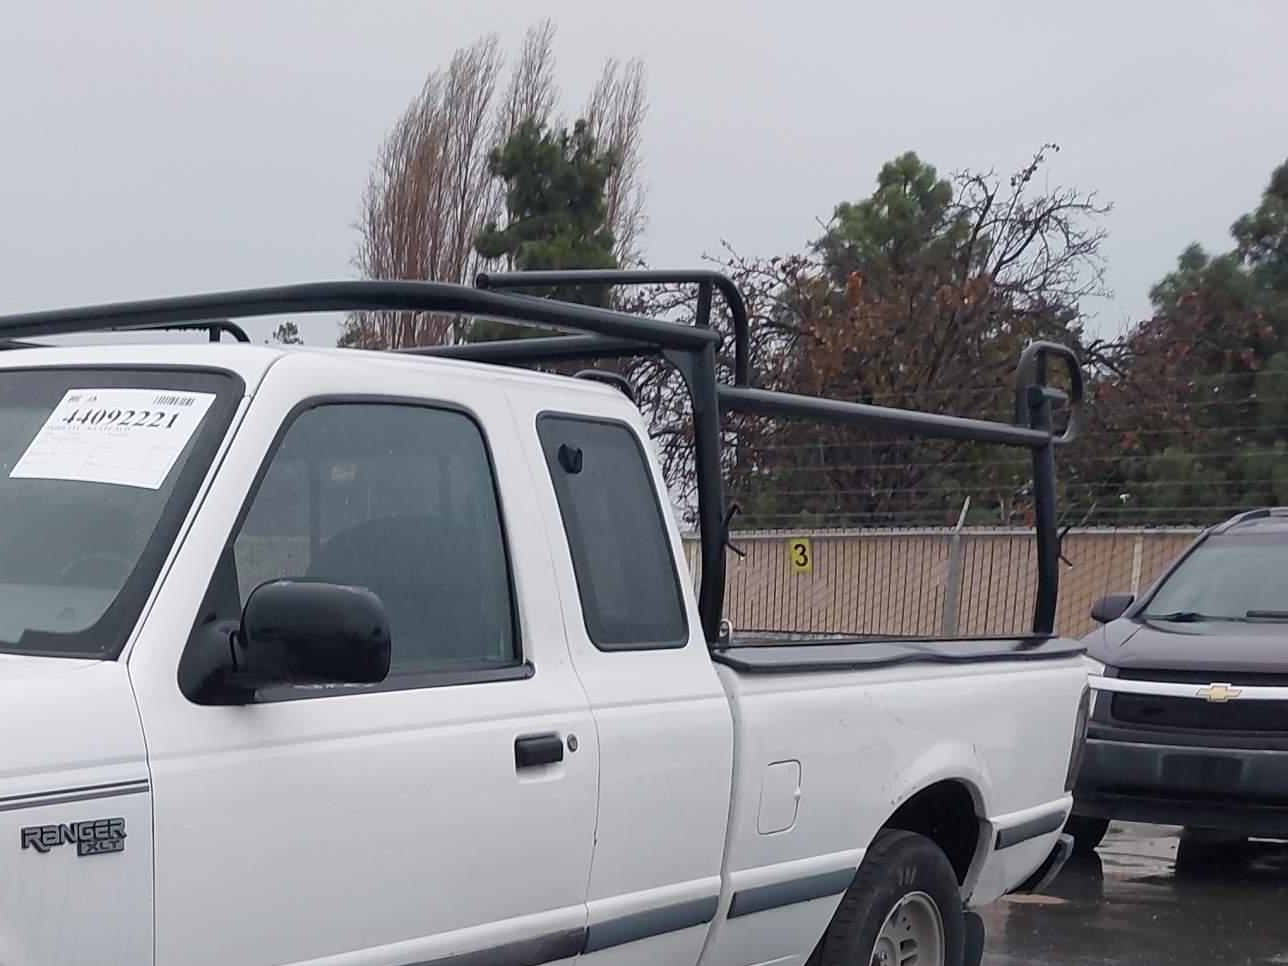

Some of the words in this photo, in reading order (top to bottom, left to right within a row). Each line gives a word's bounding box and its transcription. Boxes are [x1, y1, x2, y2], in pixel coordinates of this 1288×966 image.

[62, 408, 180, 430] 44092221
[794, 543, 809, 567] 3
[21, 817, 128, 853] RANGER
[84, 839, 122, 853] XLT
